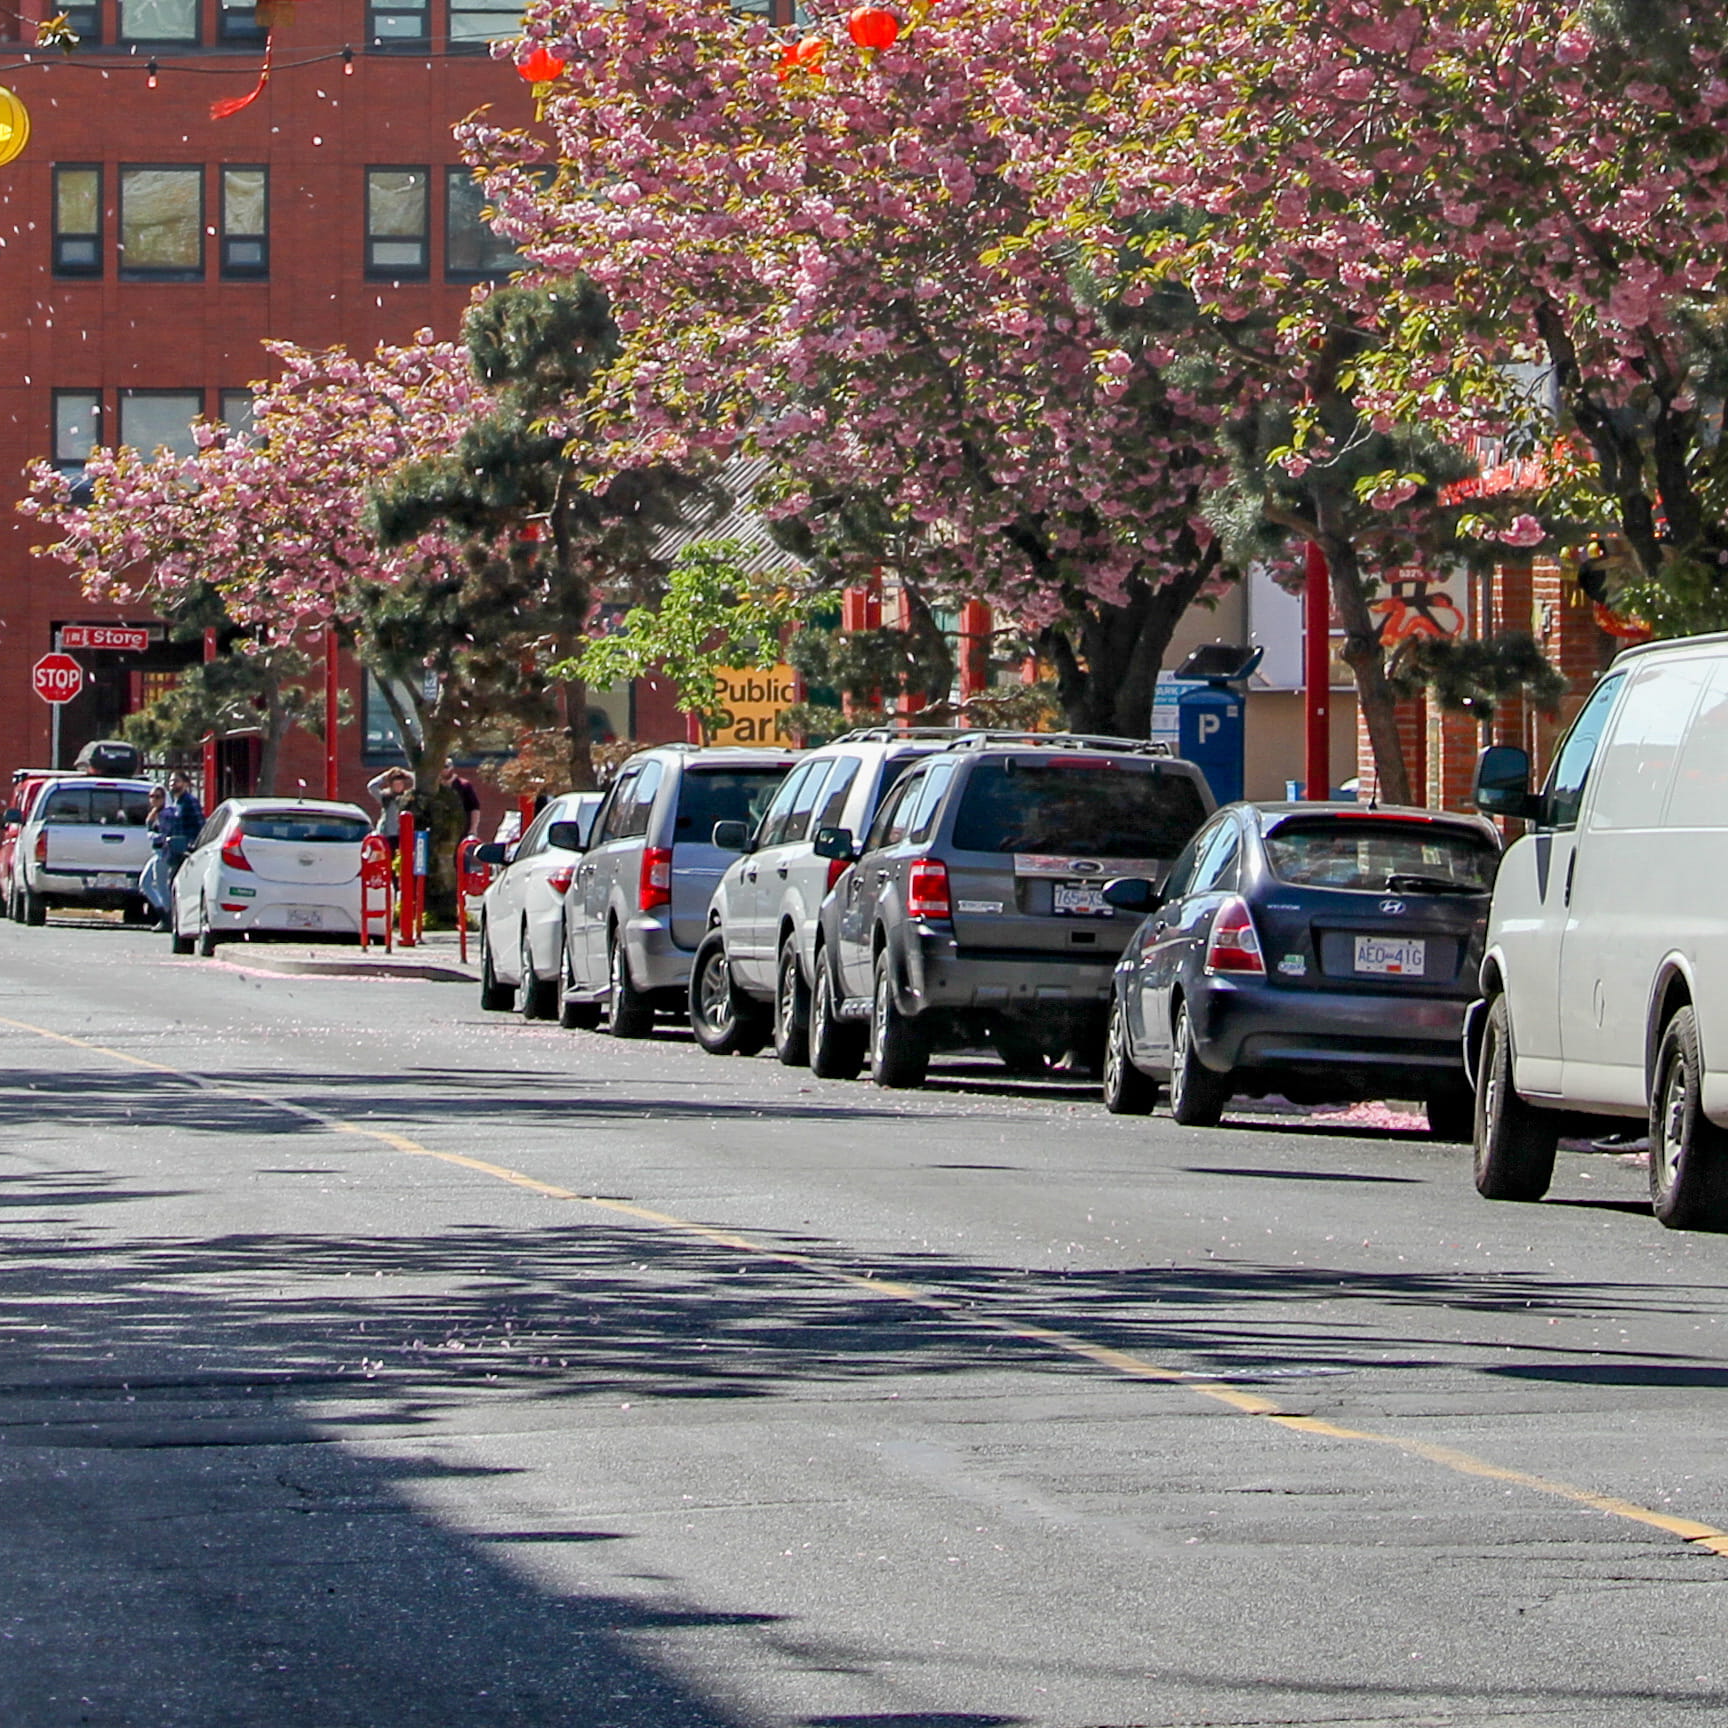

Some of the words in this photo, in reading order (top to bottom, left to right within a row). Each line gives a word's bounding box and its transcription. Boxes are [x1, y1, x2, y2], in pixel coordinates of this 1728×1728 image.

[94, 630, 143, 645] Store
[36, 668, 79, 688] STOP
[713, 677, 793, 703] Public
[1198, 713, 1220, 744] P
